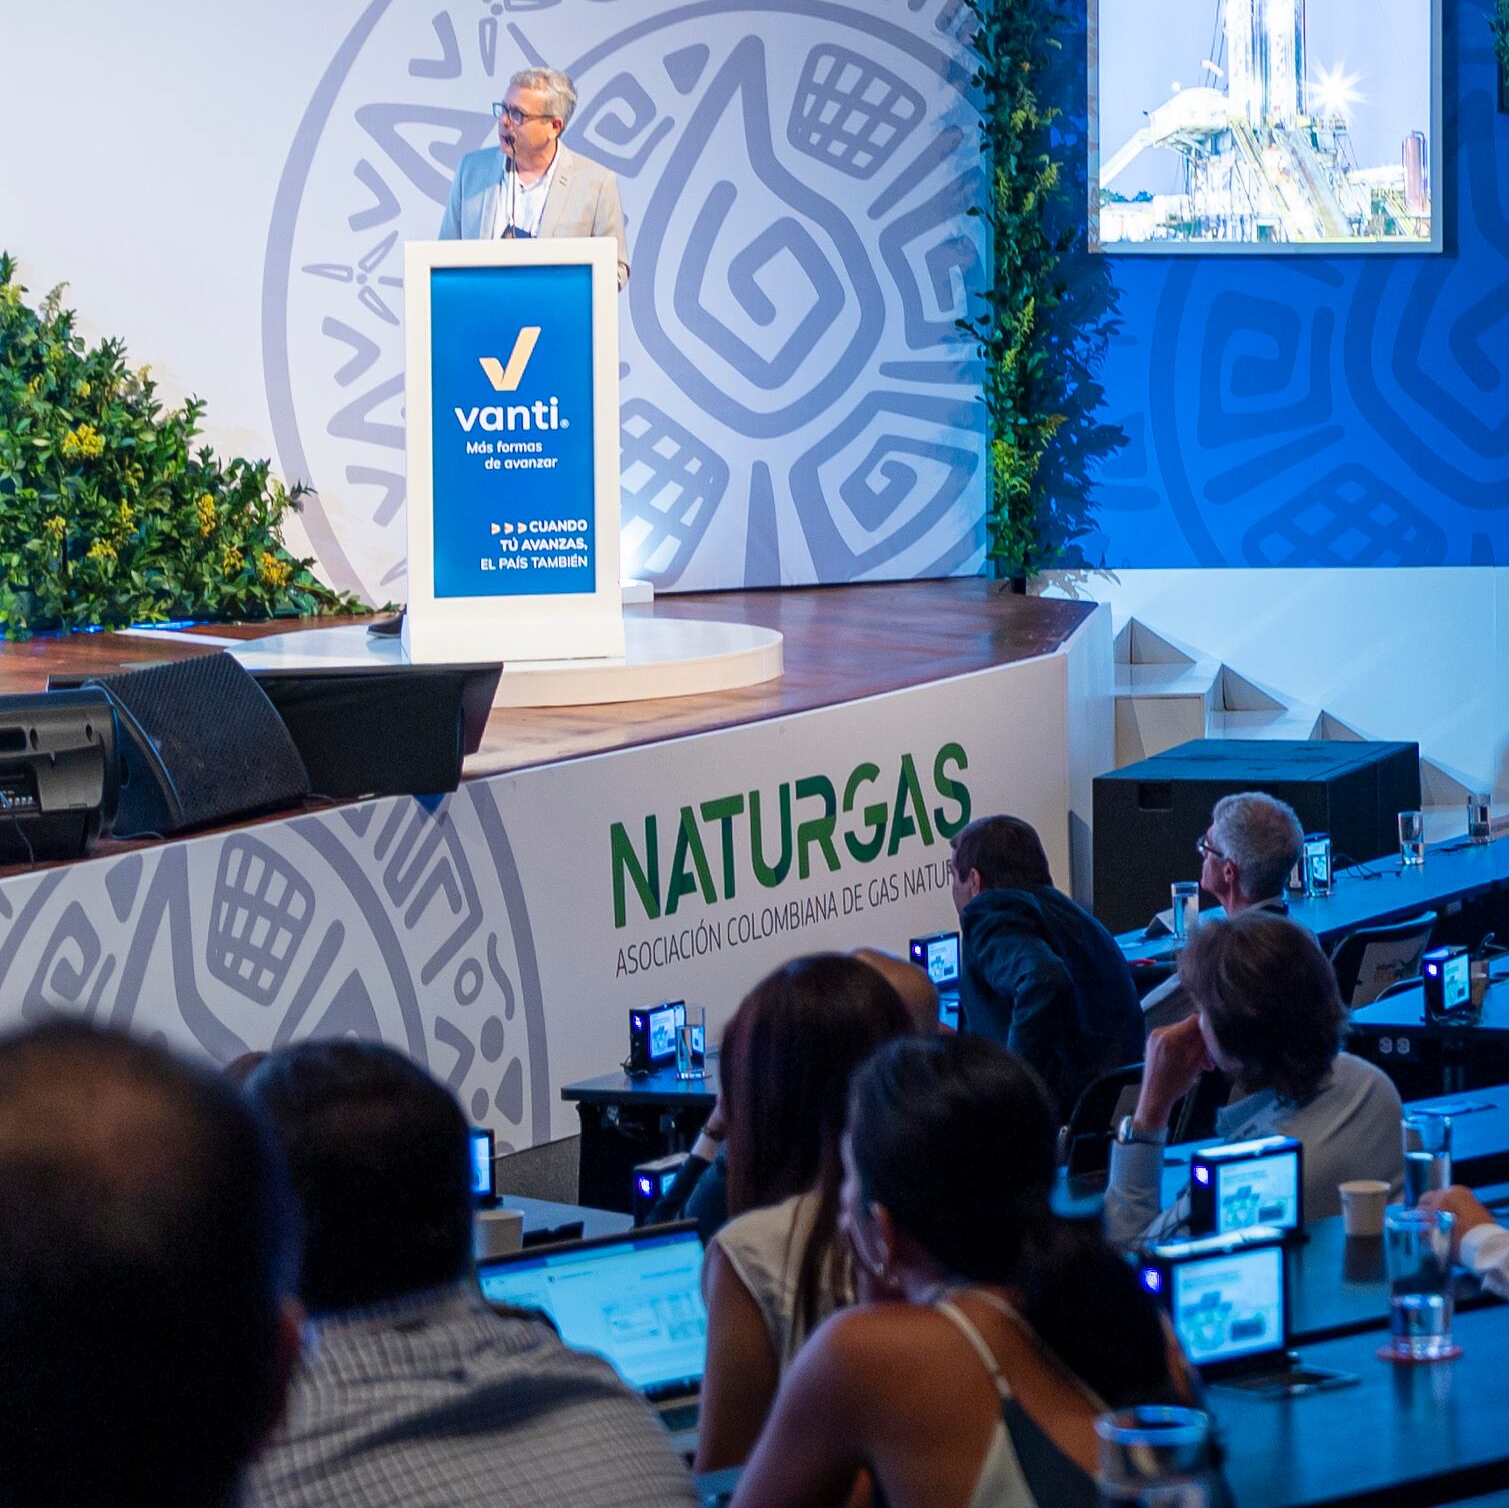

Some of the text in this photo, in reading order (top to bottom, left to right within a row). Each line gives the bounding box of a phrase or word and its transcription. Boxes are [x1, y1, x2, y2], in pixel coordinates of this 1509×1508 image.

[466, 440, 543, 454] Más formas
[485, 457, 558, 470] de avanzar
[529, 519, 588, 533] CUANDO
[500, 537, 589, 552] TÚ AVANZAS,
[480, 553, 588, 571] EL PAÍS TAMBIÉN
[610, 742, 972, 928] NATURGAS
[616, 918, 722, 979] ASOCIACIÓN
[726, 892, 839, 950] COLOMBIANA
[842, 884, 864, 914] DE
[868, 874, 900, 908] GAS
